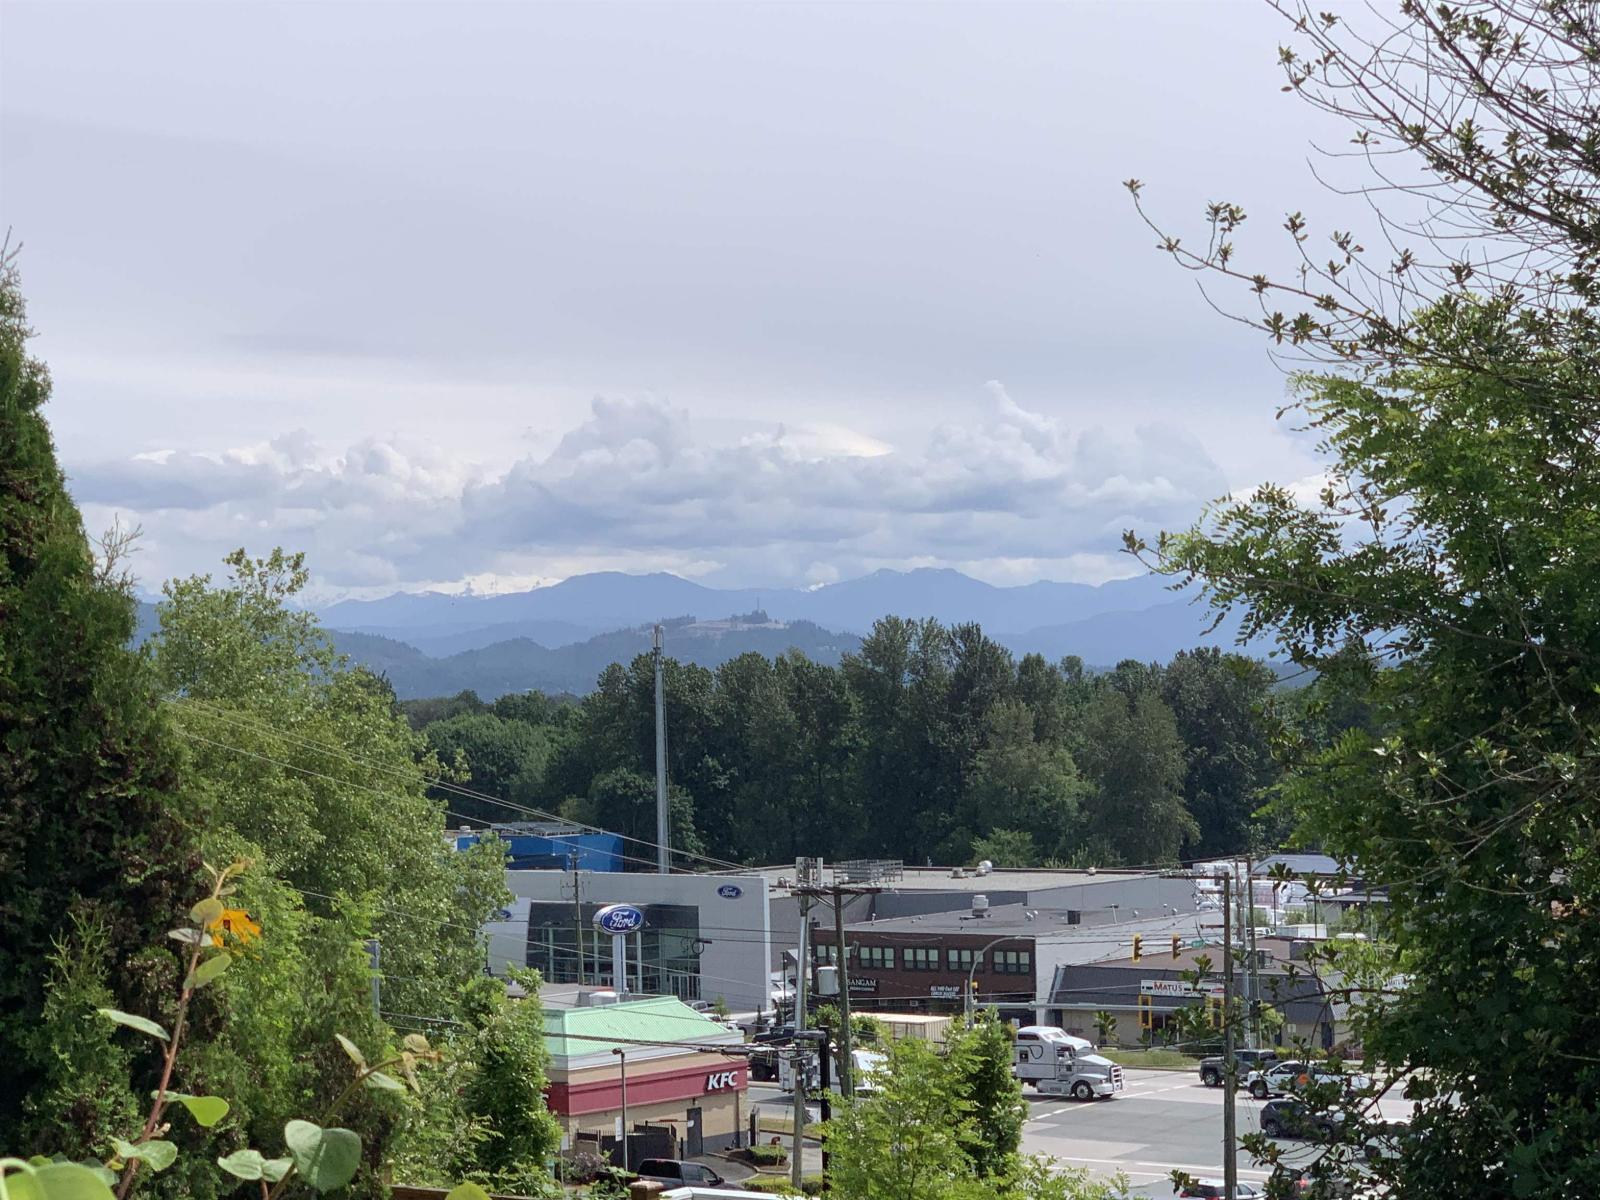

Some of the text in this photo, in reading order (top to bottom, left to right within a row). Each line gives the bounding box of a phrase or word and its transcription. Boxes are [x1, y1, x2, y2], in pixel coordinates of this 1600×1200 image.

[610, 911, 637, 929] Ford
[1153, 982, 1183, 992] MATUS
[707, 1071, 738, 1091] KFC
